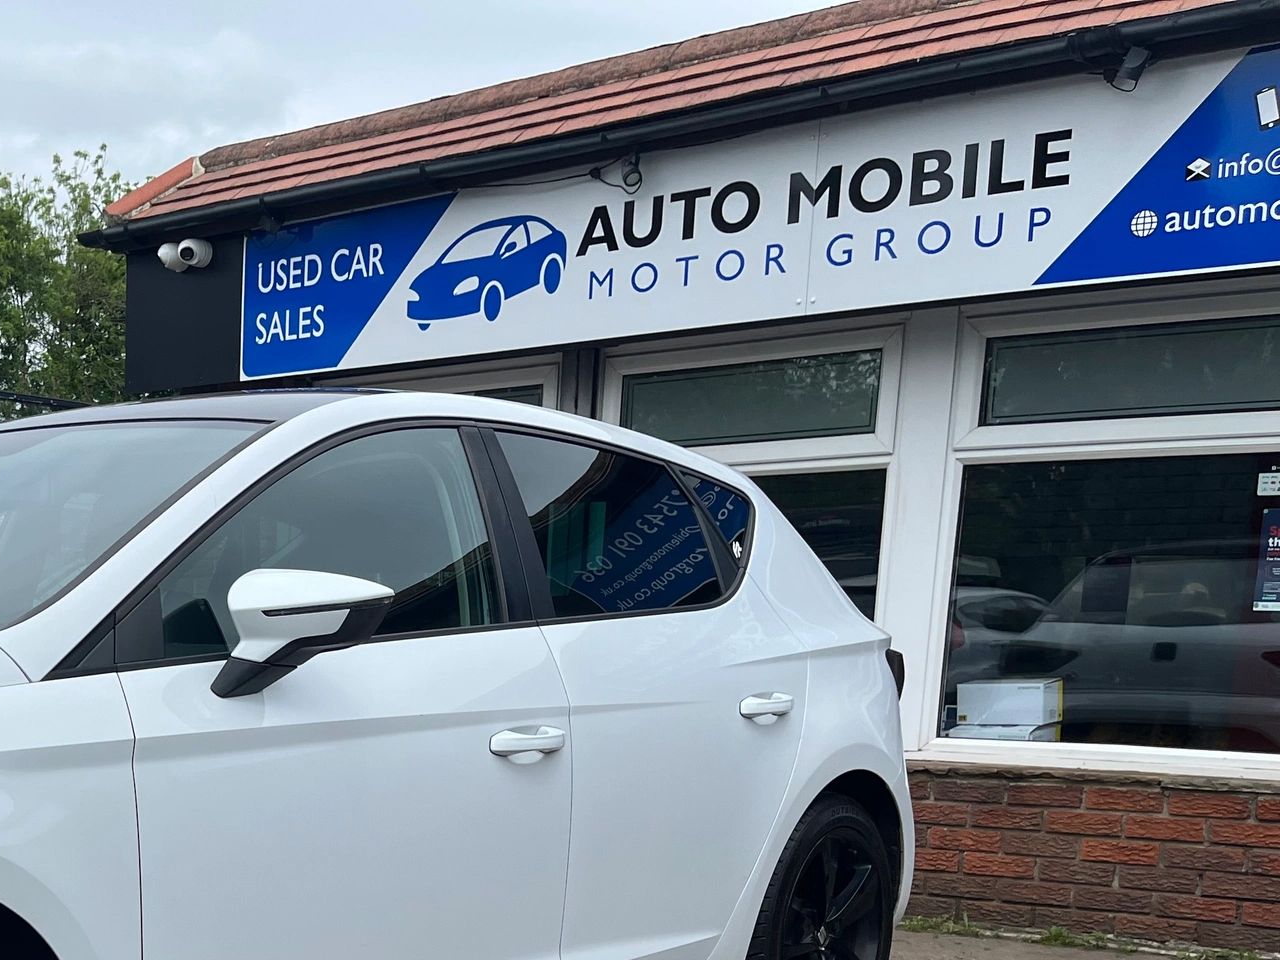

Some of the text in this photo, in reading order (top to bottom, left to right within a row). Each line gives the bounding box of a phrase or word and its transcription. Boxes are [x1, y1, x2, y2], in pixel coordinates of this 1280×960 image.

[576, 128, 1073, 257] AUTO MOBILE
[257, 243, 385, 294] USED CAR
[588, 207, 1052, 300] MOTOR GROUP
[255, 304, 325, 346] SALES
